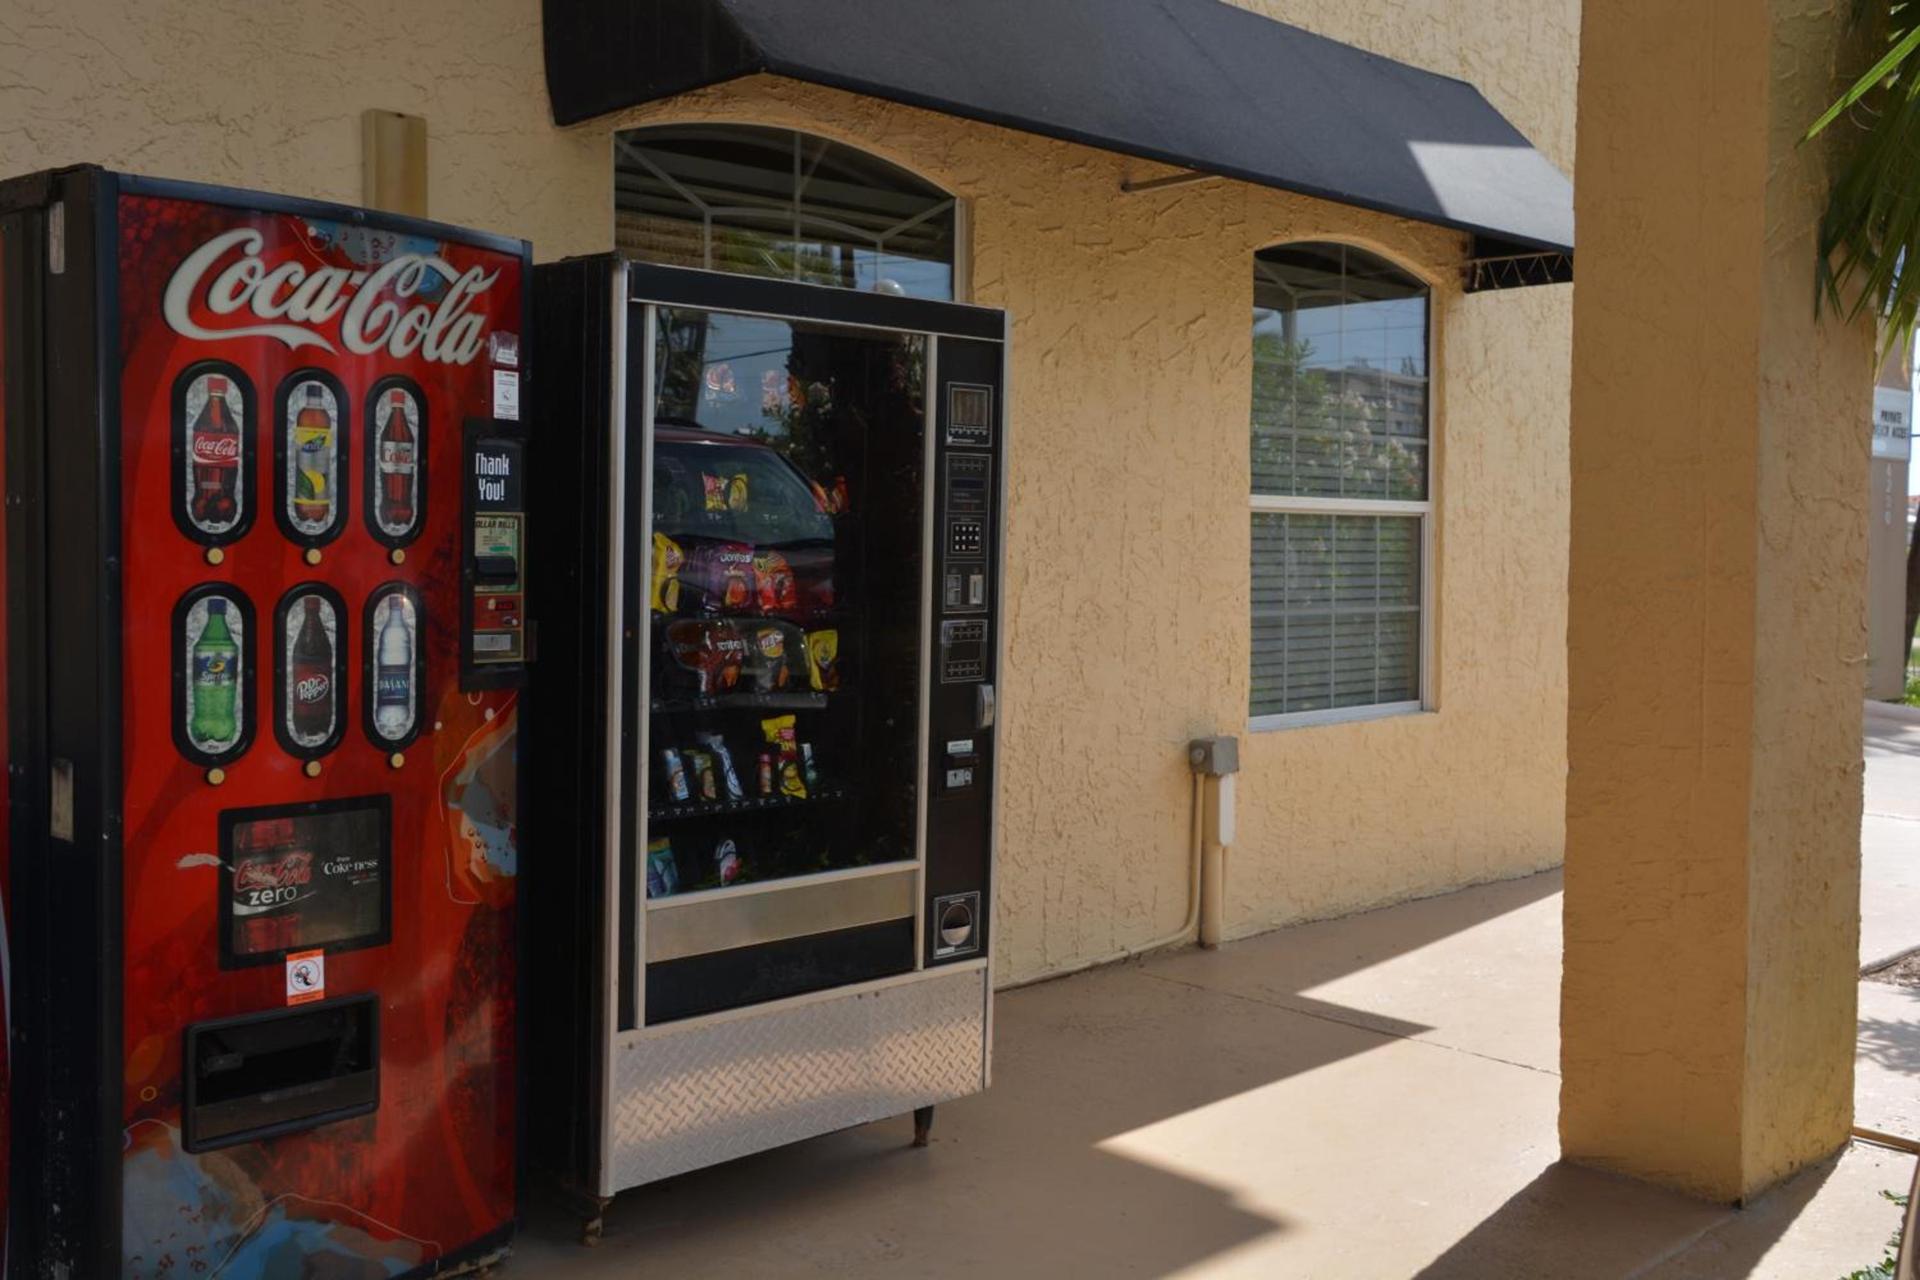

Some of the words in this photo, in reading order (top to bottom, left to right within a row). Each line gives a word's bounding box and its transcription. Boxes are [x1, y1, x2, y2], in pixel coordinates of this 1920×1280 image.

[163, 227, 503, 366] Coca-Cola
[194, 436, 238, 456] Coca-Cola
[475, 452, 510, 475] Thank
[478, 479, 505, 501] You!
[249, 886, 298, 906] zero
